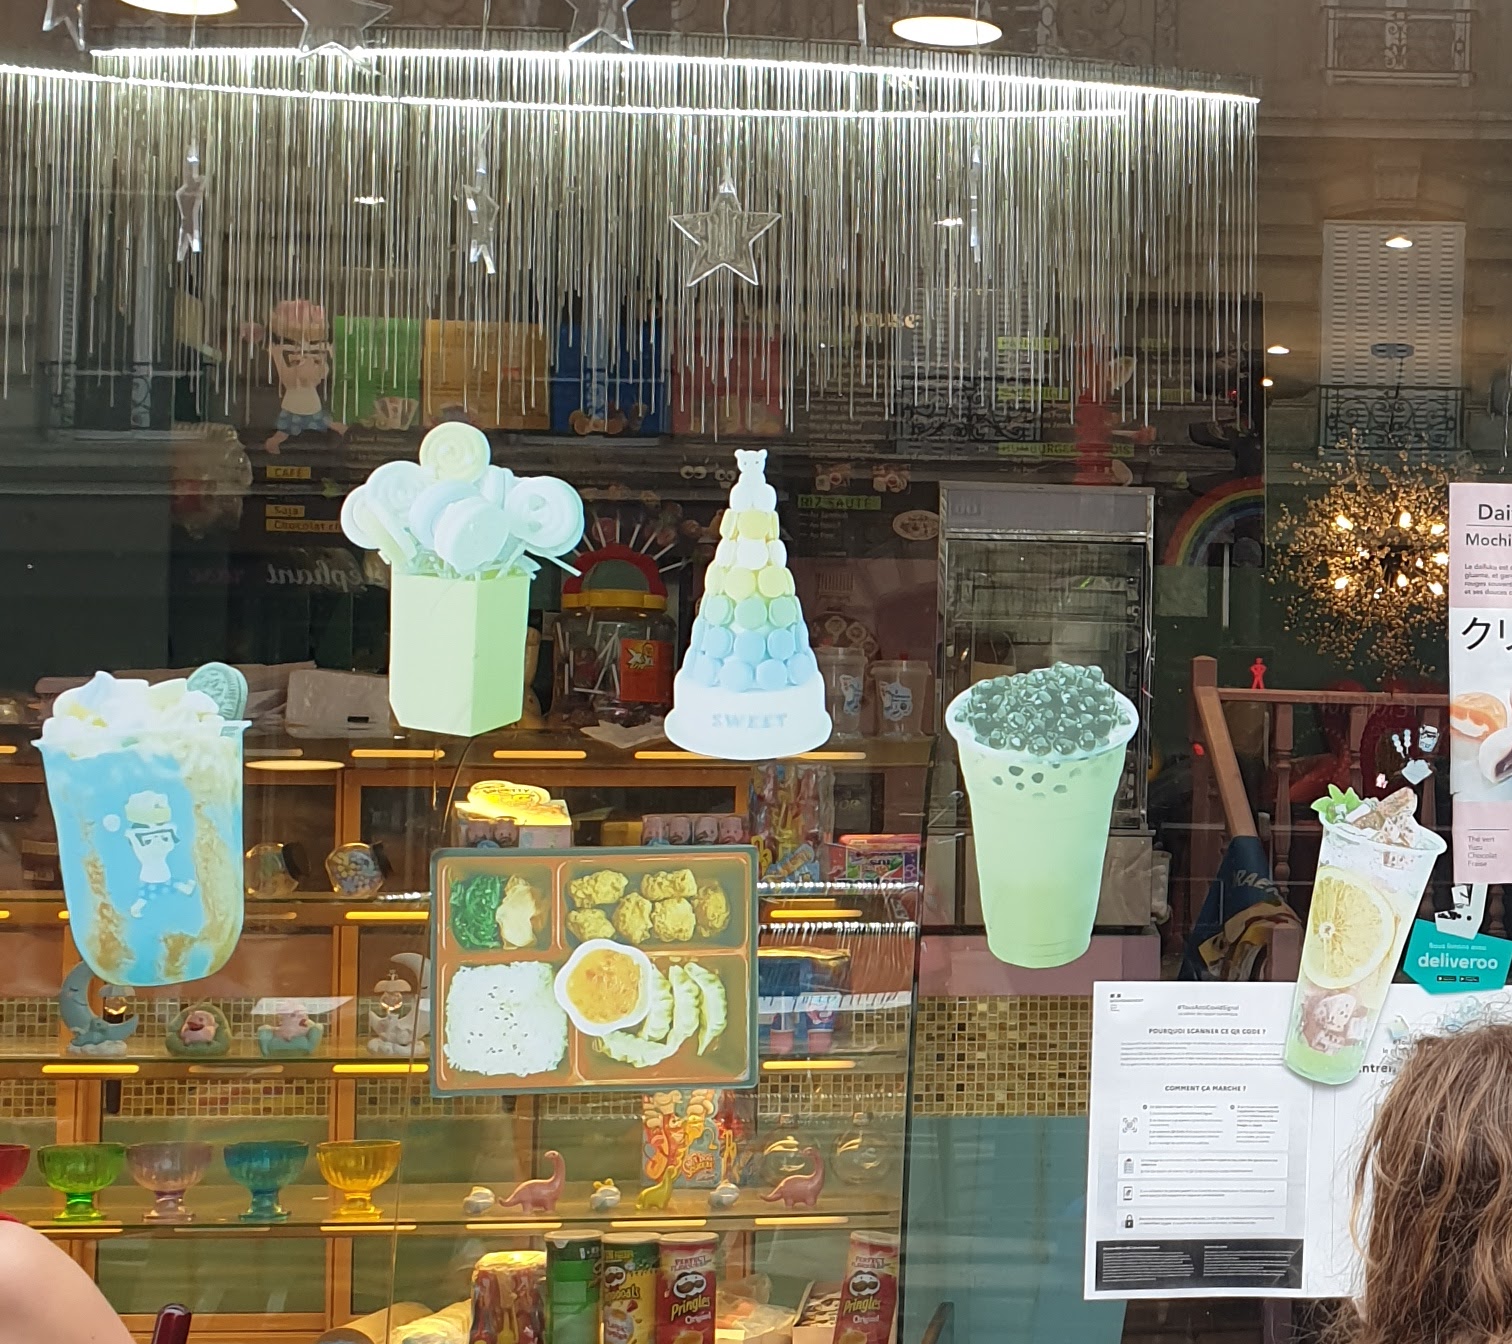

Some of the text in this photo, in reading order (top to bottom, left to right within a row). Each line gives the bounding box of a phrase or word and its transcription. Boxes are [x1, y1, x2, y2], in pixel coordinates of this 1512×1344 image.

[1465, 532, 1511, 547] Mochi
[712, 712, 787, 729] SWEET
[1418, 952, 1498, 970] deliveroo
[1201, 1085, 1211, 1093] ÇA
[671, 1295, 711, 1322] Pringles
[843, 1296, 882, 1316] Pringles
